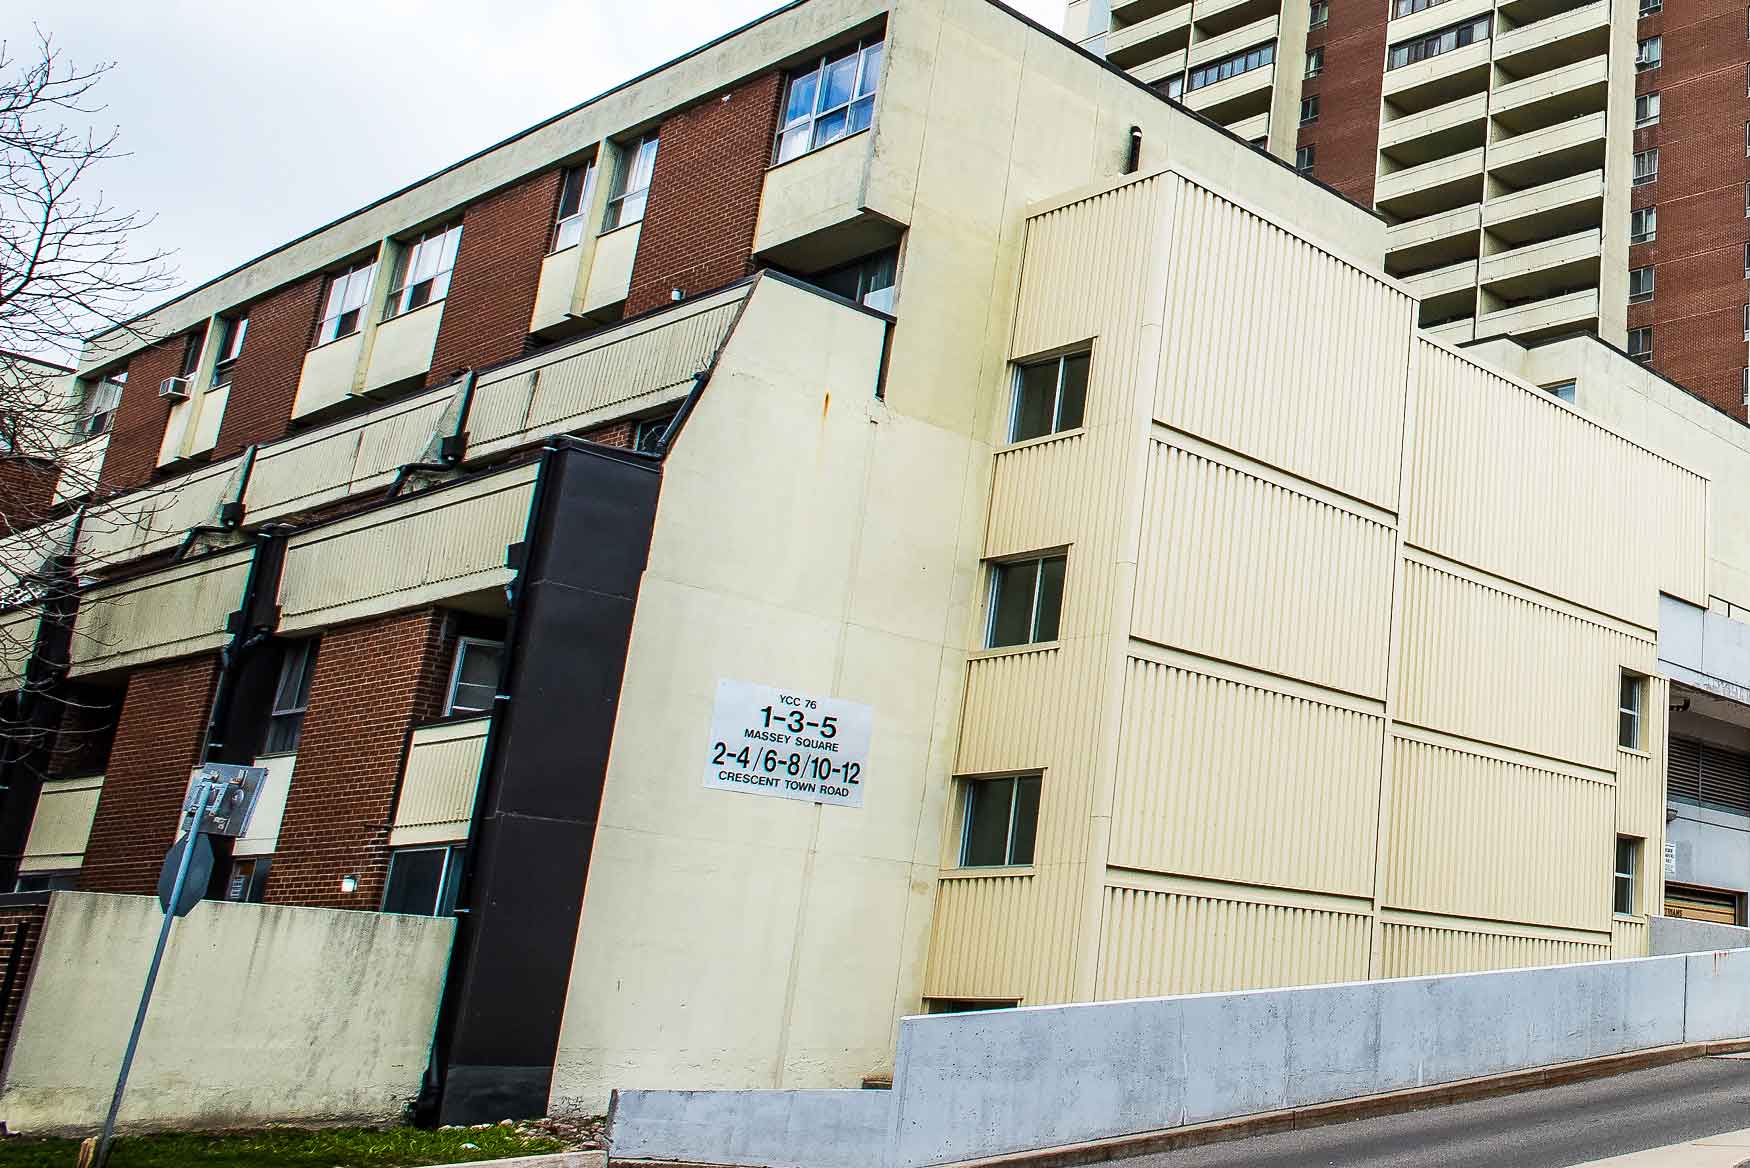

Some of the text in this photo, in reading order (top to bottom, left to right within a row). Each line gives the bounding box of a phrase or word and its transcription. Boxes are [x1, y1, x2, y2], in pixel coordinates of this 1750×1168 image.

[779, 694, 817, 710] YCC 76
[760, 705, 838, 739] 1-3-5
[744, 728, 839, 752] MASSEY SQUARE
[718, 770, 849, 797] CRESCENT TOWN ROAD
